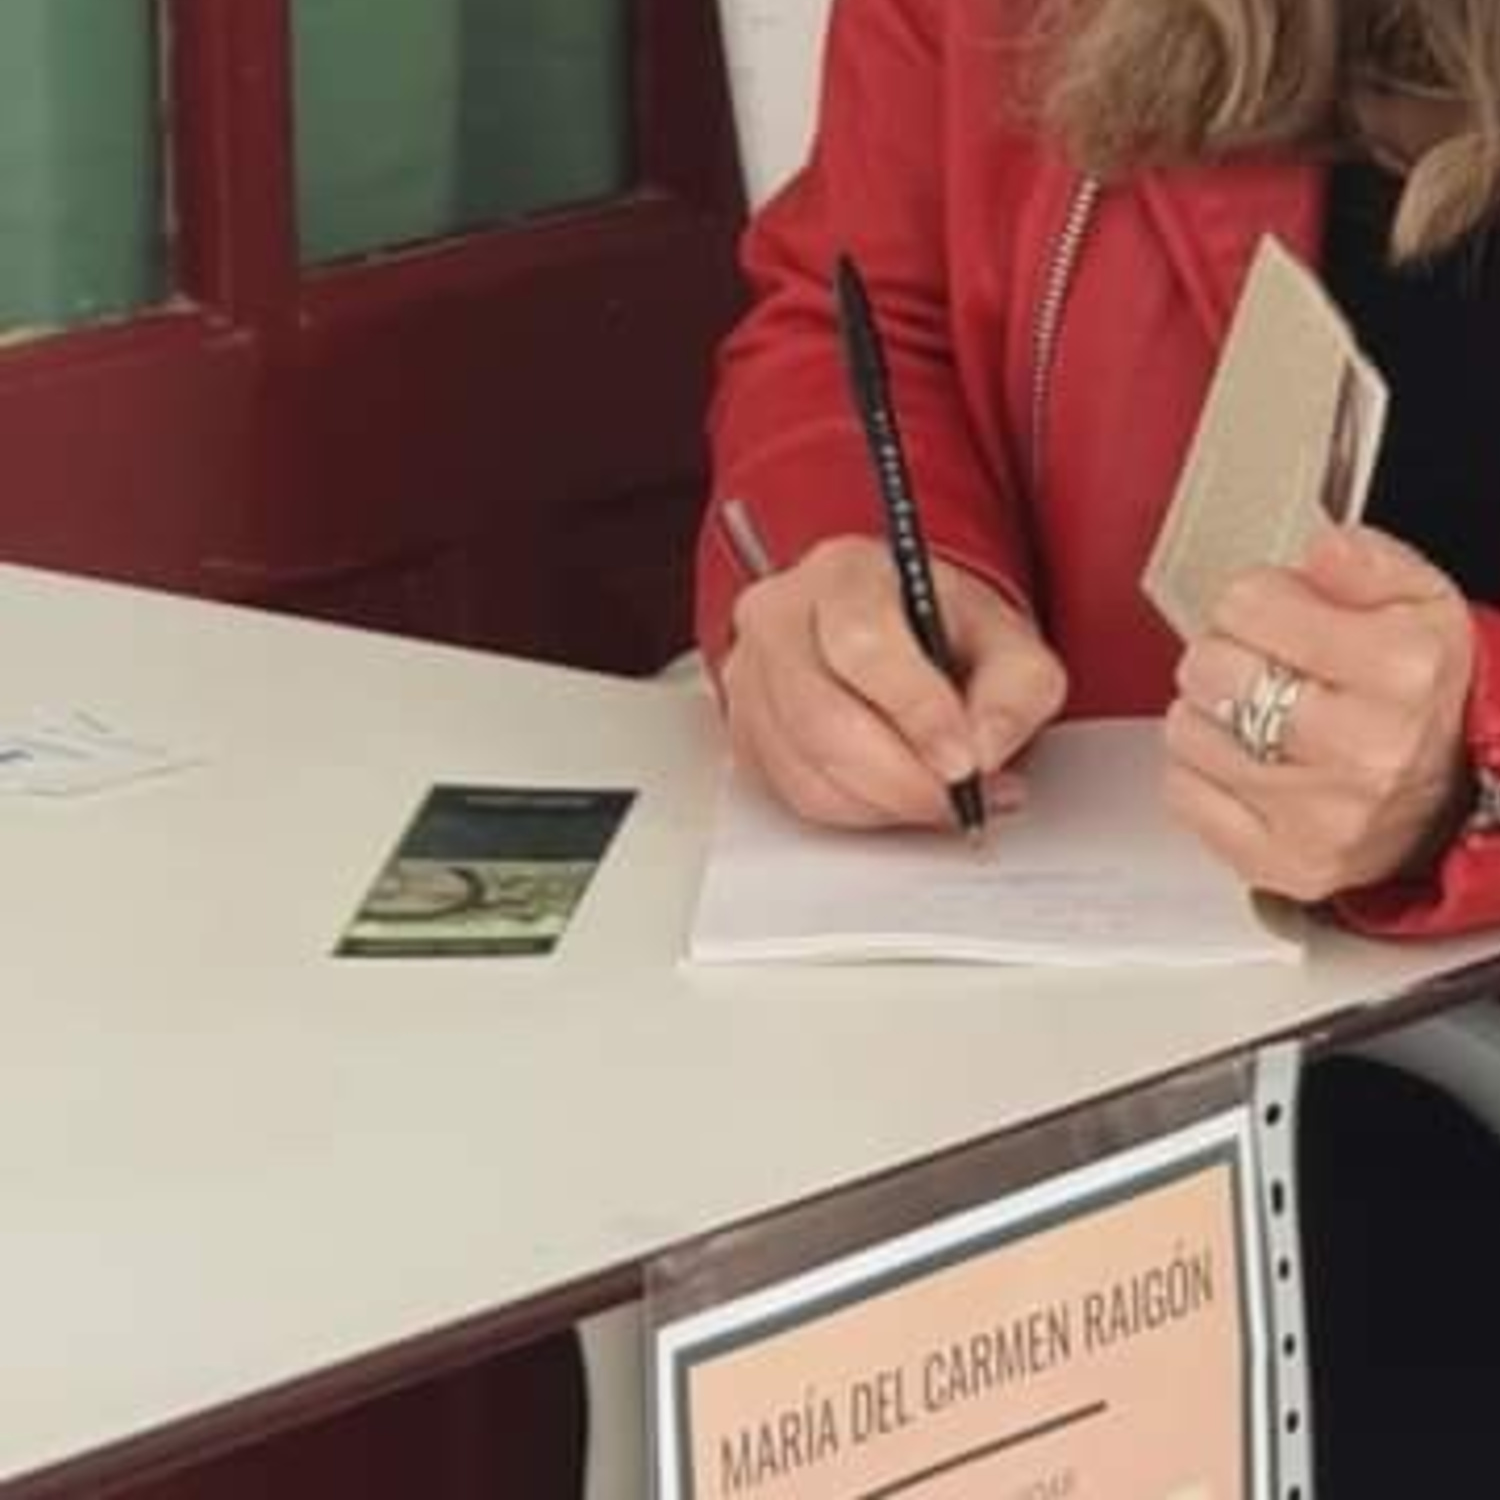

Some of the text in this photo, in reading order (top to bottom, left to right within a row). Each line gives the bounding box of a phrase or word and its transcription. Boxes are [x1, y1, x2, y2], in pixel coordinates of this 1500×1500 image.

[719, 1240, 1215, 1494] MARÍA DEL CARMEN RAIGÓN
